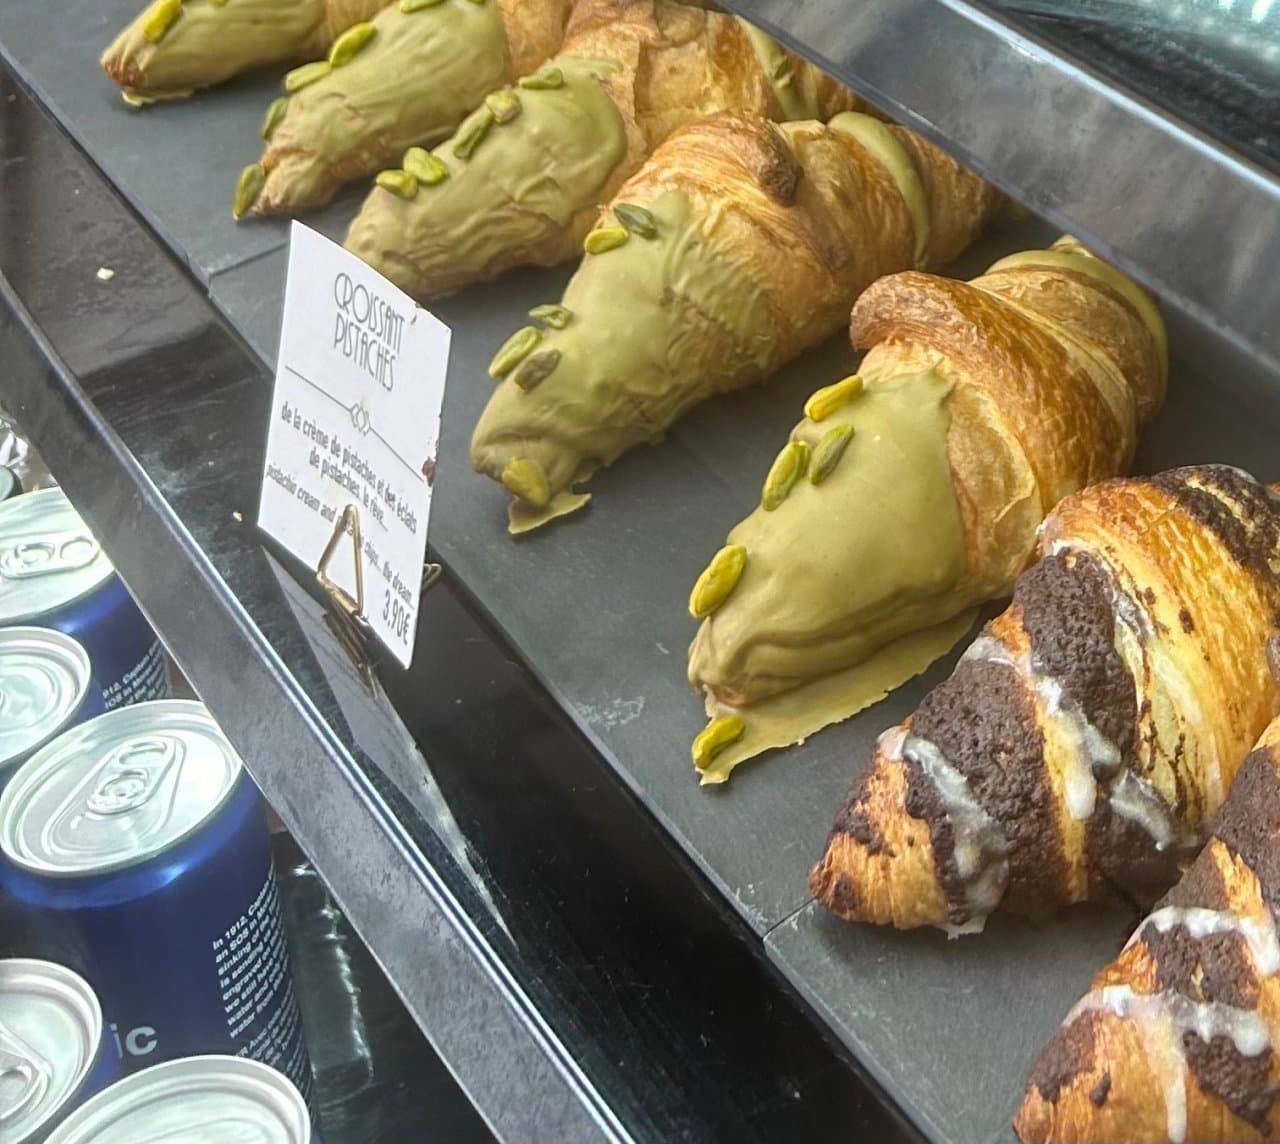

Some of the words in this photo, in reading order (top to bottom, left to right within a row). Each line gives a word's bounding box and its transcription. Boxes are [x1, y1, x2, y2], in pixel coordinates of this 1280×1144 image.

[334, 272, 405, 355] CROISSANT
[333, 311, 396, 392] PISTACHES
[281, 401, 292, 424] de
[293, 408, 302, 430] la
[302, 419, 329, 450] crème
[330, 435, 341, 458] de
[342, 445, 376, 489] pistaches
[377, 479, 385, 498] et
[384, 483, 396, 512] des
[397, 496, 417, 534] éclats
[309, 446, 320, 469] de
[297, 487, 321, 512] cream
[212, 938, 223, 951] In
[215, 949, 229, 963] an
[230, 927, 249, 951] SOS
[218, 942, 252, 976] sinking
[232, 941, 264, 980] sending
[223, 957, 262, 1001] engraved
